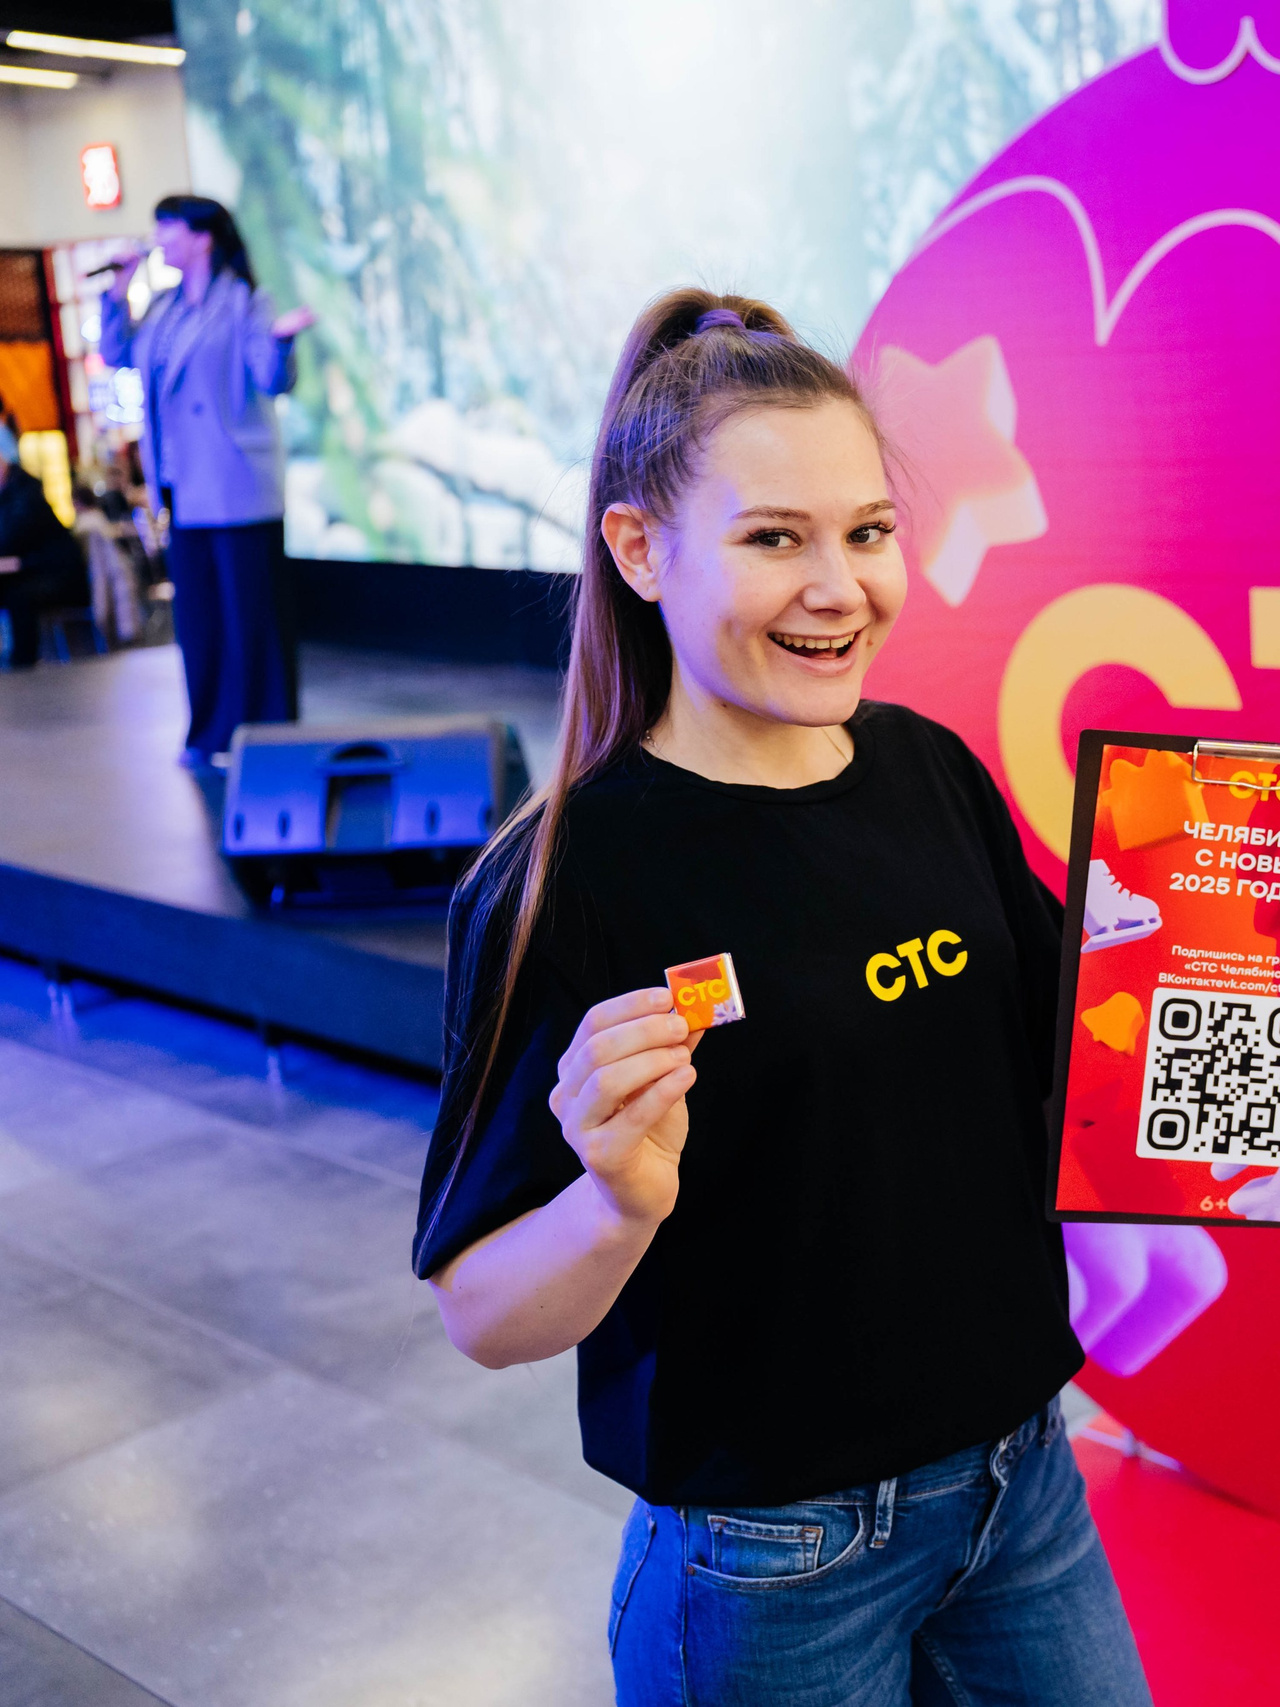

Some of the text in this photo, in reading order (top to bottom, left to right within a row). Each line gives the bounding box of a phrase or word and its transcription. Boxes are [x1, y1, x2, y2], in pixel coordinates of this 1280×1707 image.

[1195, 849, 1214, 867] С
[1169, 872, 1231, 895] 2025
[1171, 945, 1245, 962] Подпишись
[1247, 953, 1263, 963] на
[865, 929, 968, 1002] СТС
[1184, 961, 1218, 974] «СТС
[677, 978, 727, 1007] СТС
[1199, 1195, 1228, 1212] 6+
